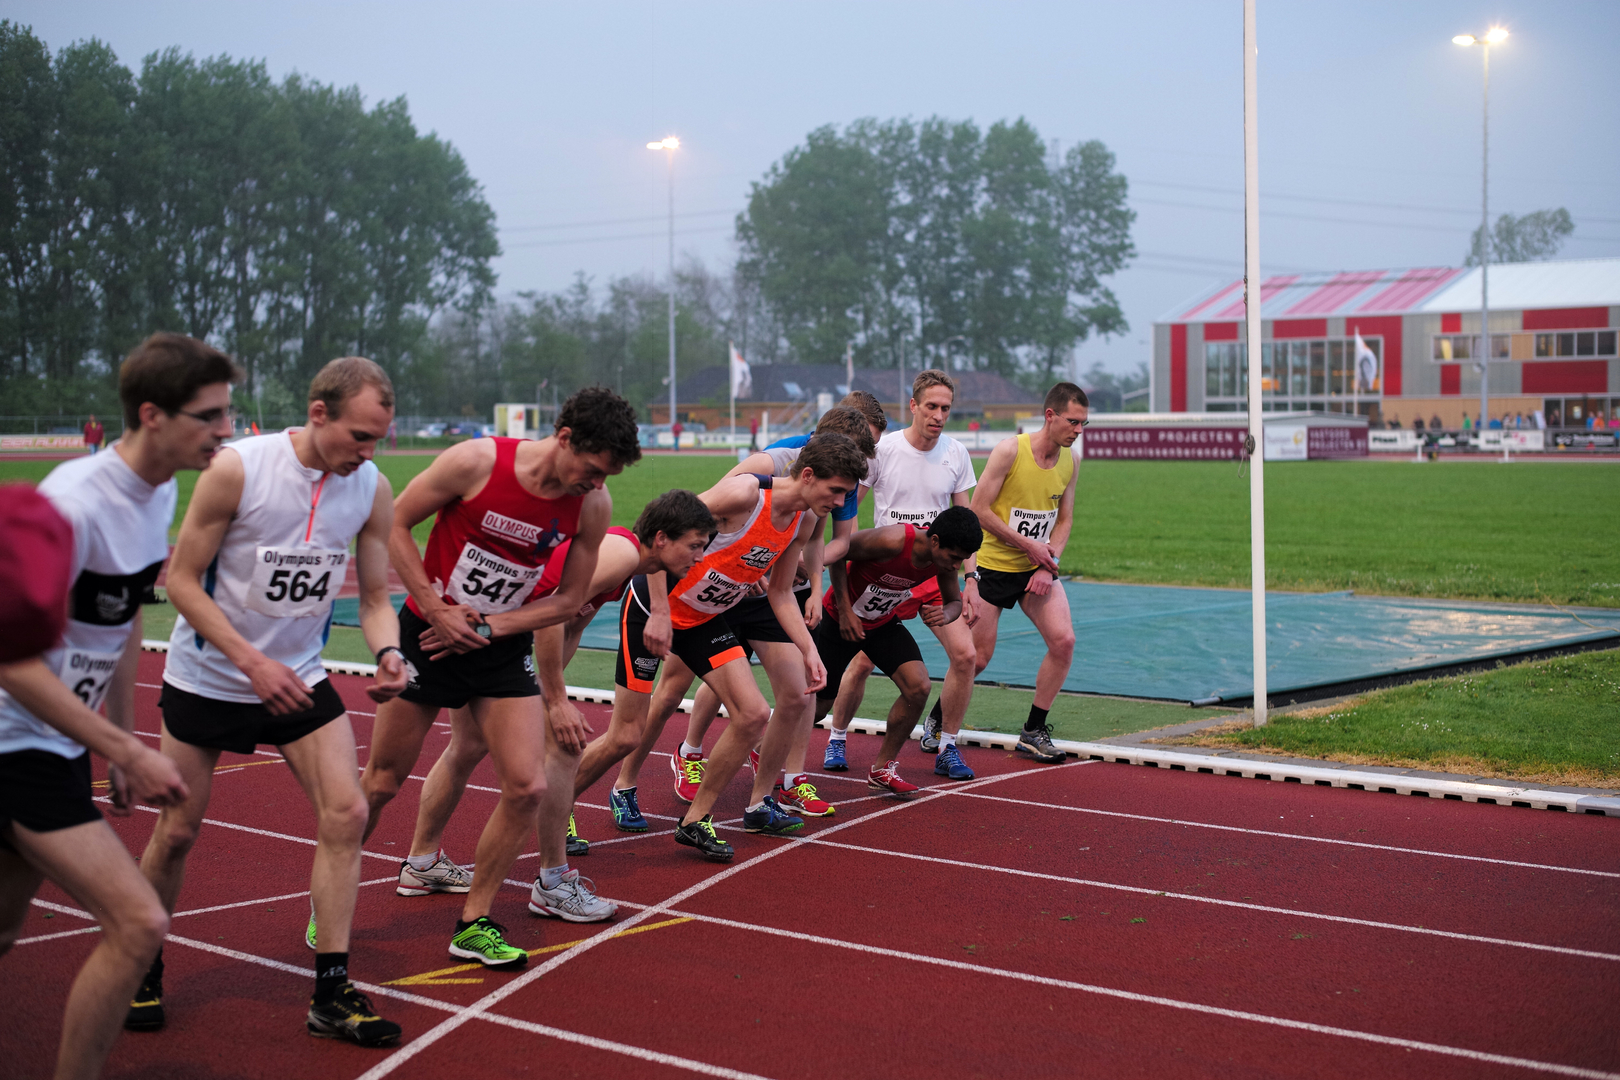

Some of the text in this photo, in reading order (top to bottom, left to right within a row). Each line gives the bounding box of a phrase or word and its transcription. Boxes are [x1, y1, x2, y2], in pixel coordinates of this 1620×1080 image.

[1086, 430, 1150, 443] VASTGOED
[1158, 430, 1234, 443] PROJECTEN
[890, 510, 938, 521] Olympus '70
[1014, 509, 1046, 520] Olympus
[485, 514, 537, 540] OLYMPUS
[1017, 520, 1049, 539] 641
[264, 551, 345, 567] Olympus '70
[467, 548, 519, 578] Olympus
[265, 569, 332, 602] 564
[462, 567, 525, 604] 547
[708, 571, 741, 590] Olympus
[697, 584, 741, 607] 544
[870, 585, 902, 598] Olympus
